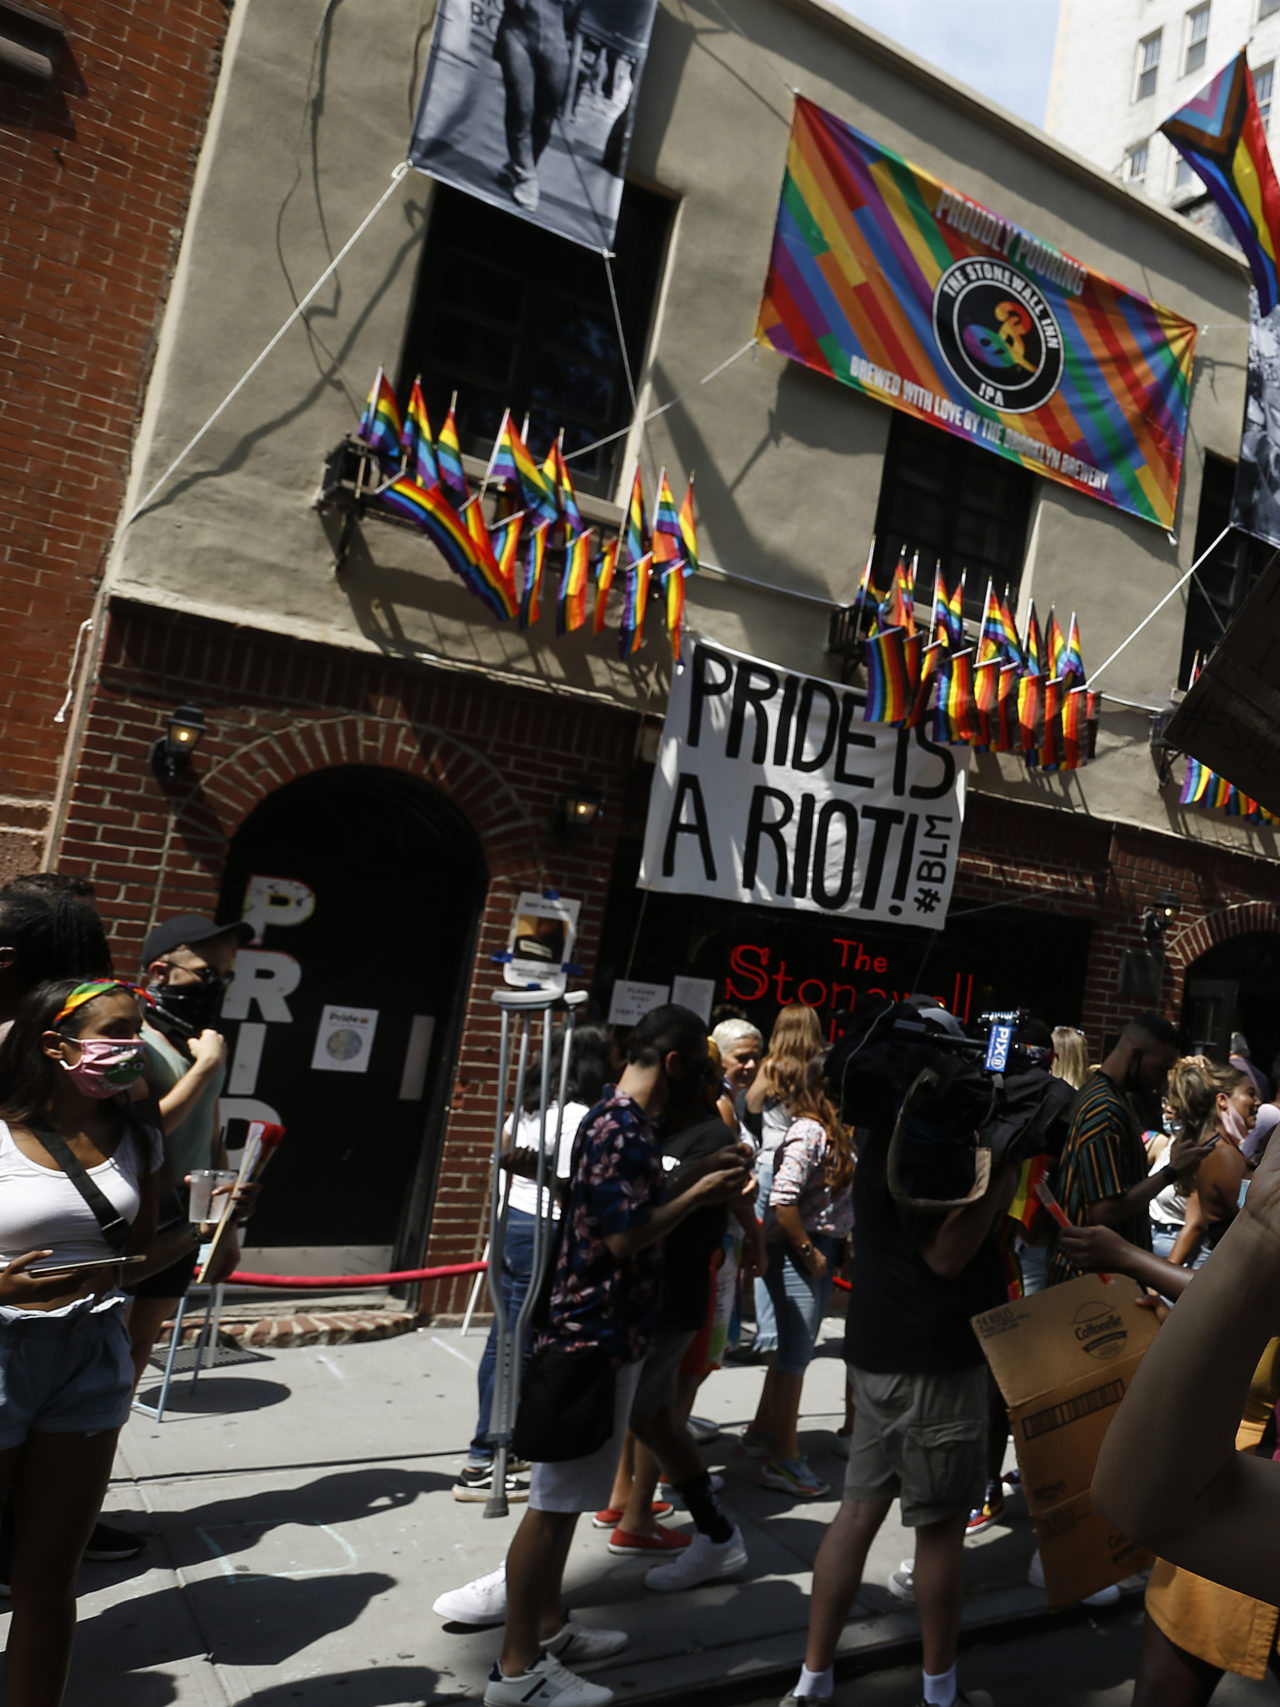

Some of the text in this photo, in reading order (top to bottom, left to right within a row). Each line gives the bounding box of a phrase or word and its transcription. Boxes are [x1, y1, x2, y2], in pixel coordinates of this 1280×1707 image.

[936, 187, 1088, 297] PROUDLY POURING
[941, 263, 1060, 350] THE STONEWALL INN
[849, 354, 1110, 491] BREWED WITH LOVE BY THE BROOKLYN BREWERY
[978, 382, 1005, 407] IPA
[687, 644, 956, 800] PRIDE IS
[662, 772, 919, 917] A RIOT!
[913, 814, 954, 914] #BLM
[832, 937, 888, 974] The
